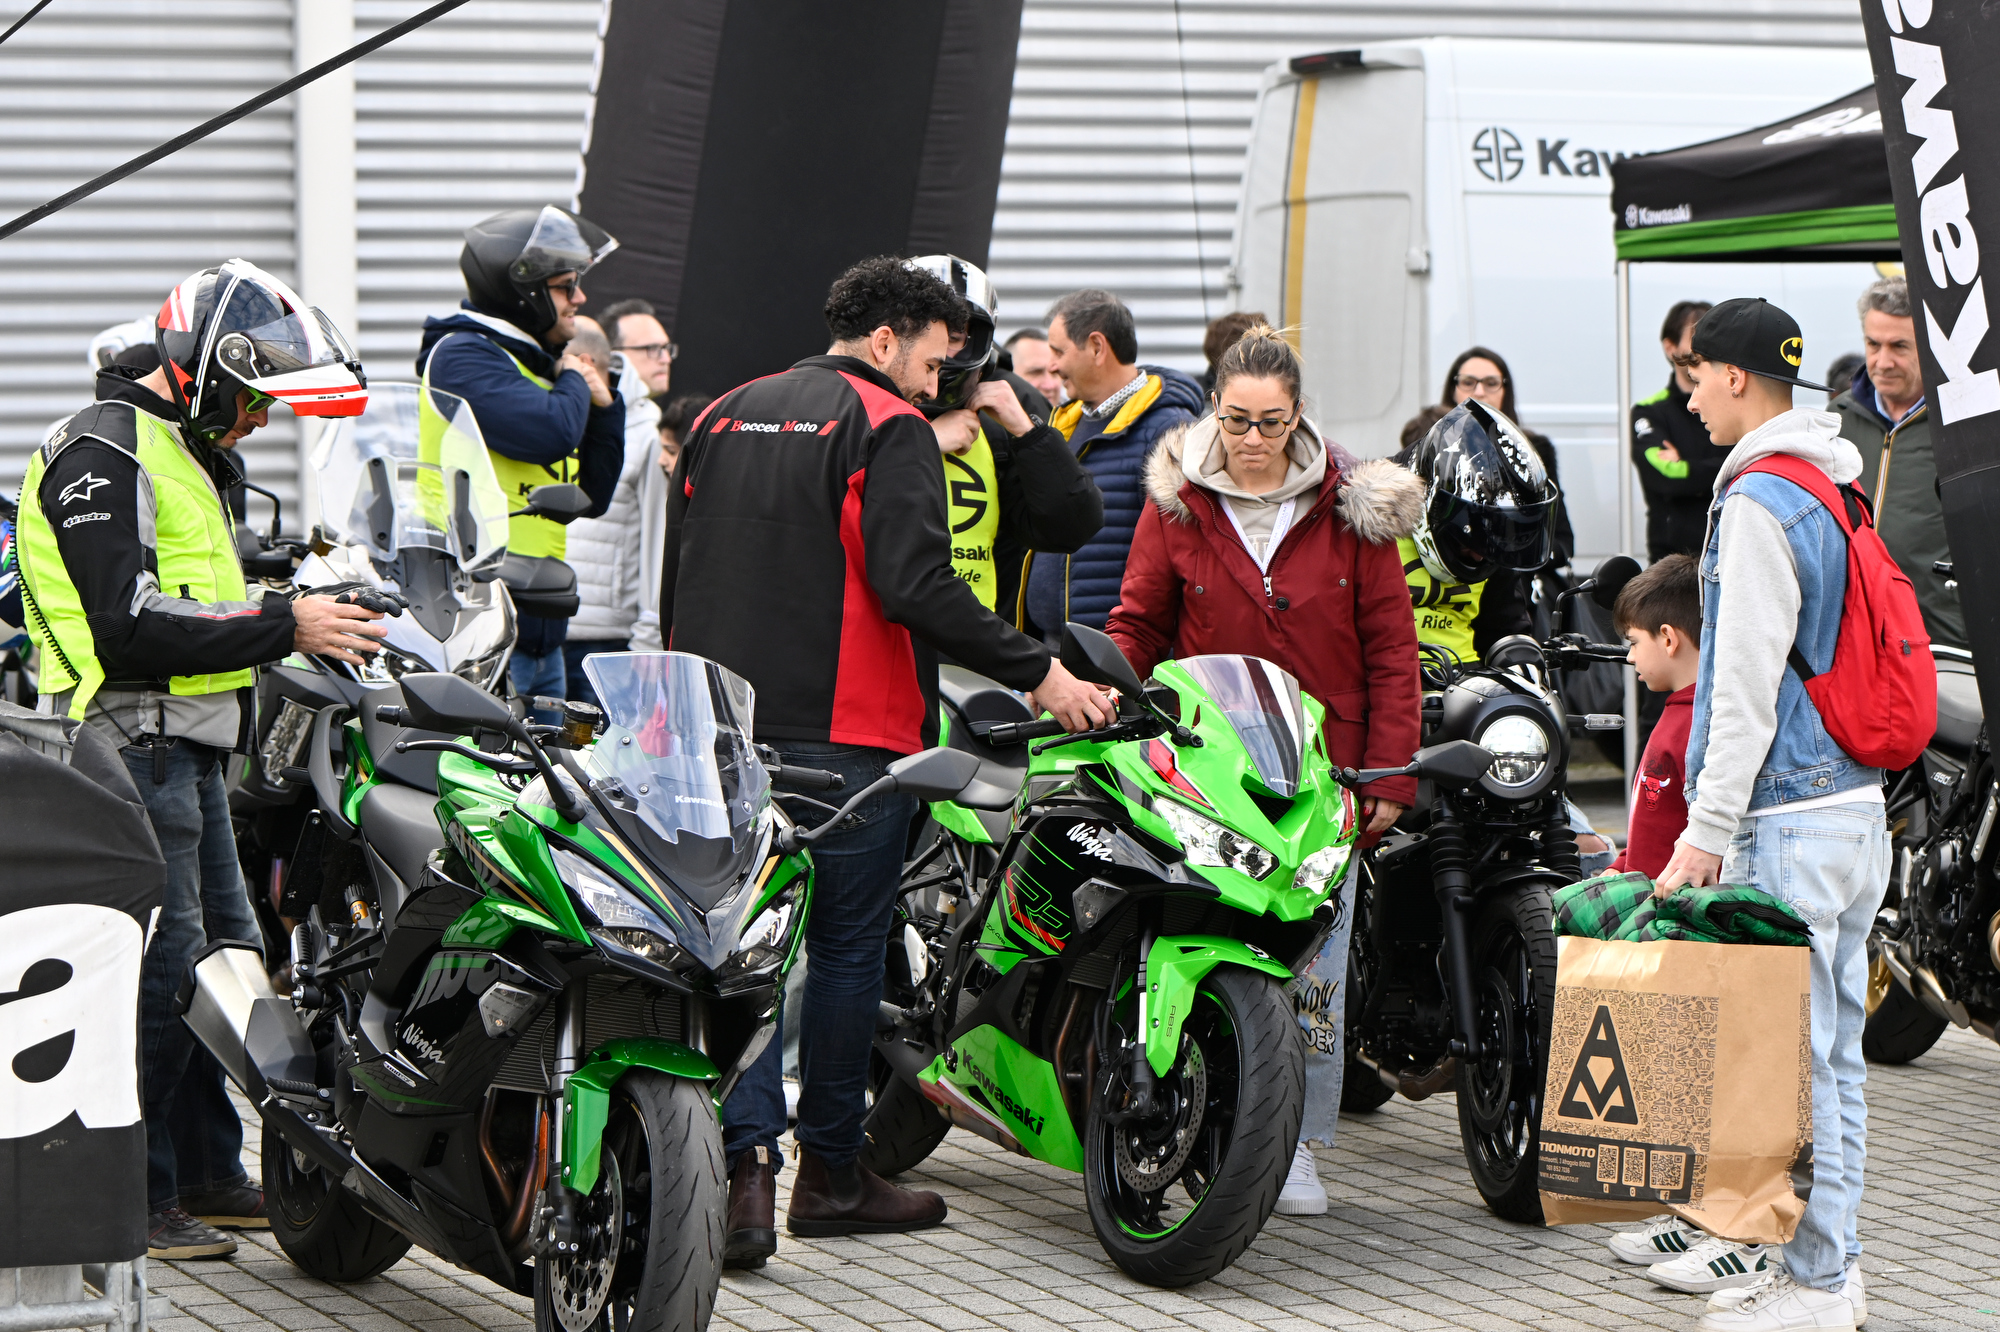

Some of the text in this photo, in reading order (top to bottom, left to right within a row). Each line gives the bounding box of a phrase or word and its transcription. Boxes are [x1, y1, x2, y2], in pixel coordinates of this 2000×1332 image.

[1639, 204, 1692, 226] Kawasaki
[730, 420, 818, 433] Boccea Moto
[1421, 615, 1453, 629] Ride
[1066, 822, 1113, 862] Ninja
[1166, 1005, 1177, 1038] ABS
[402, 1023, 446, 1065] Ninja
[962, 1048, 1045, 1137] Kawasaki
